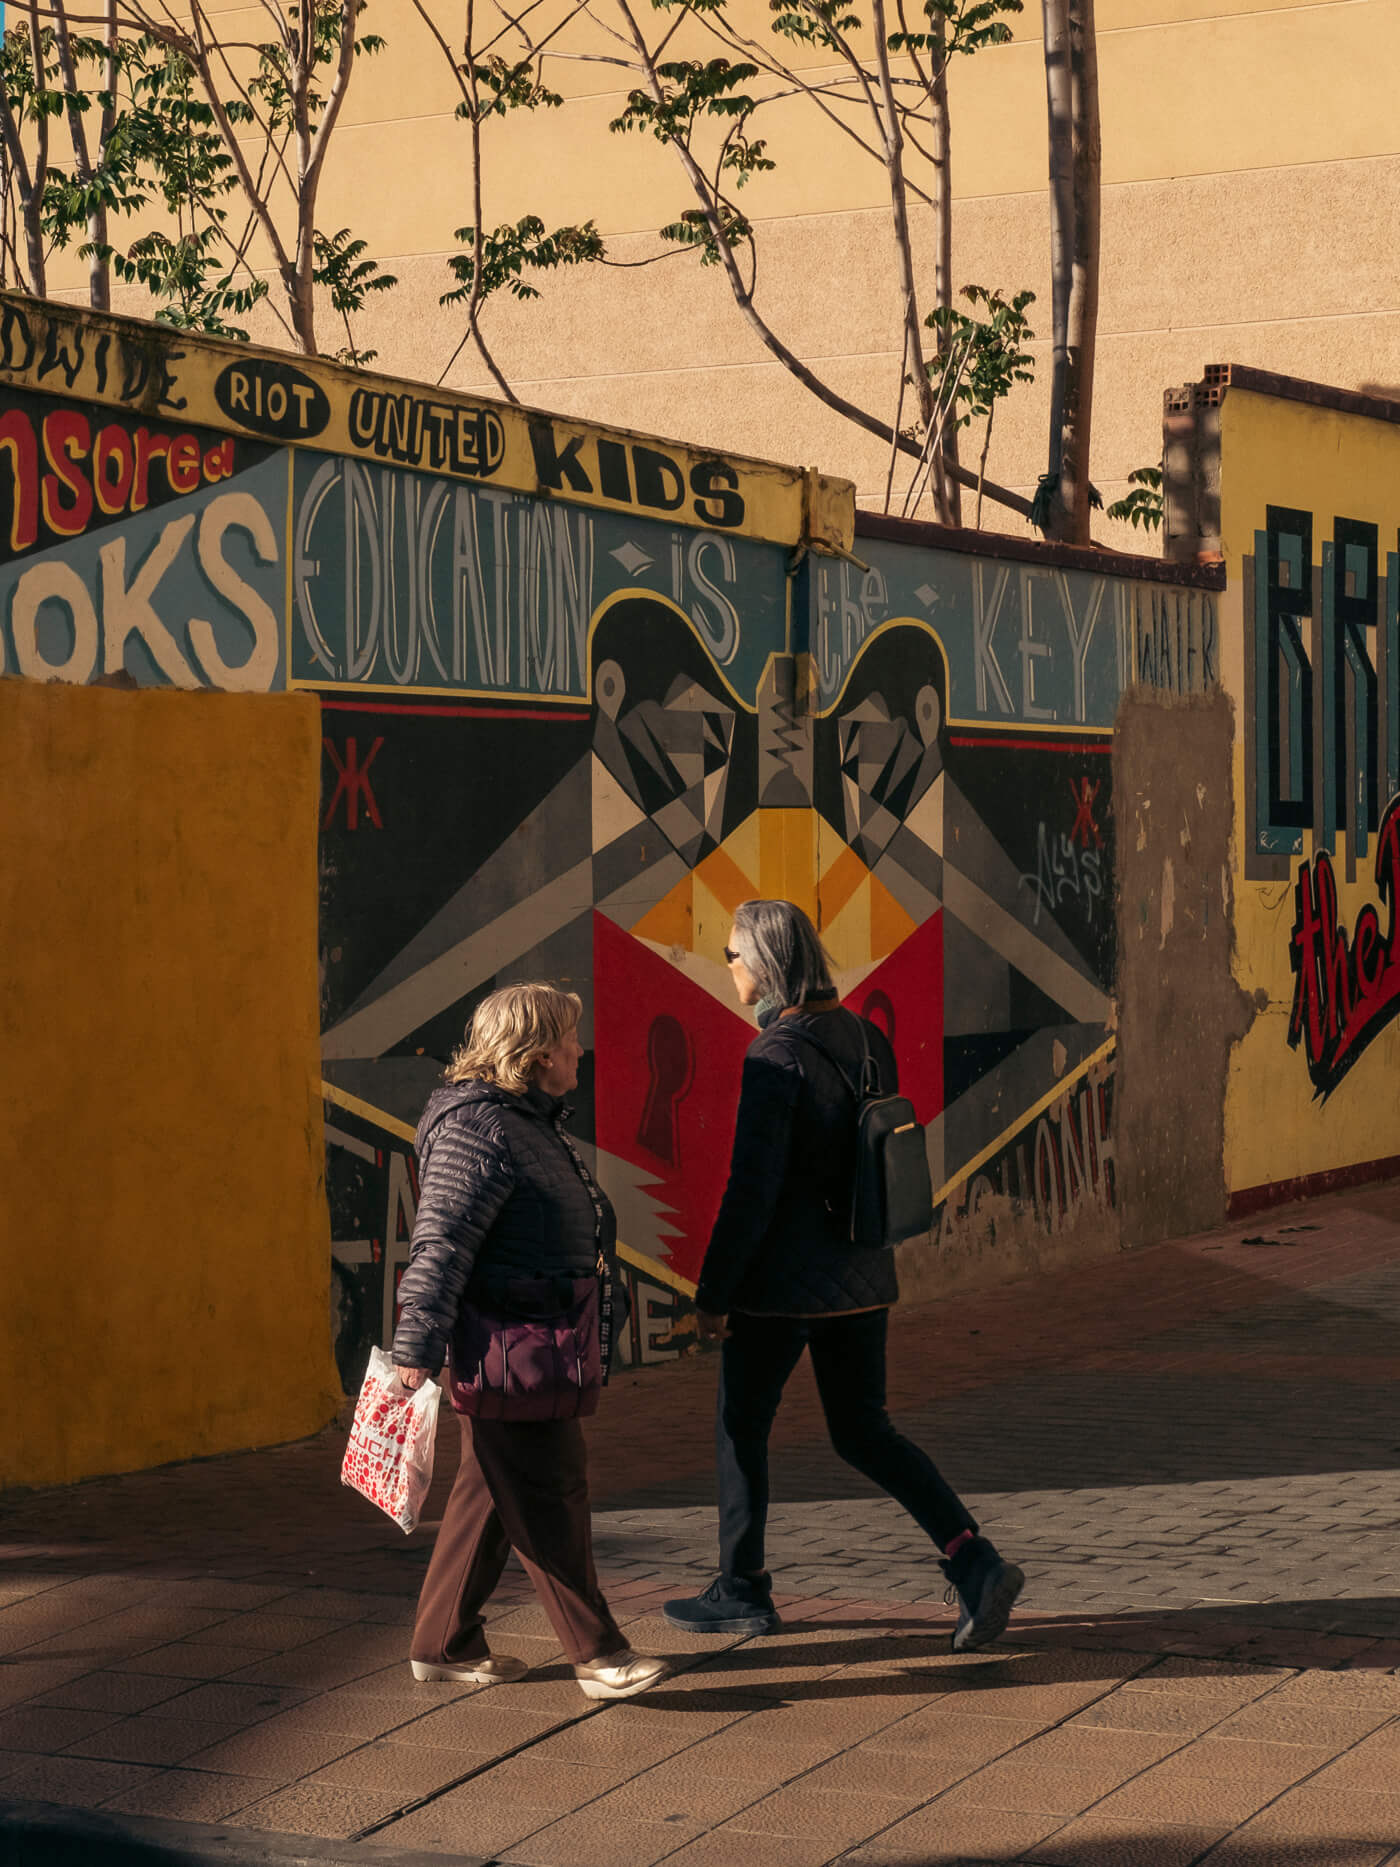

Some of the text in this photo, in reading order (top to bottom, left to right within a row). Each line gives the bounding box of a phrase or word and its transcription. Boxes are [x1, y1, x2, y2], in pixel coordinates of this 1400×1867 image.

[230, 371, 316, 429] RIOT
[348, 387, 506, 477] UNITED
[529, 422, 745, 528] KIDS
